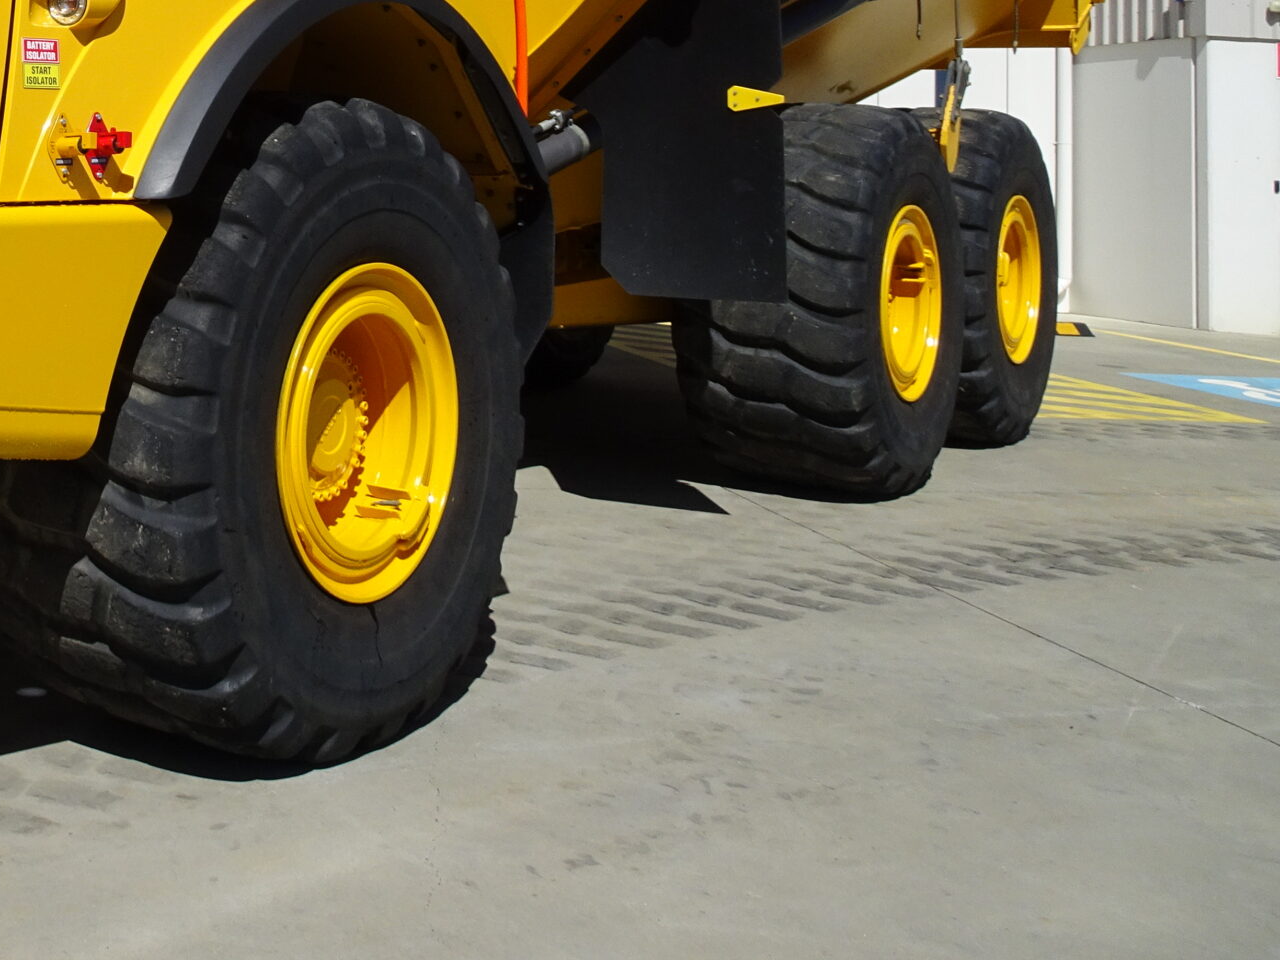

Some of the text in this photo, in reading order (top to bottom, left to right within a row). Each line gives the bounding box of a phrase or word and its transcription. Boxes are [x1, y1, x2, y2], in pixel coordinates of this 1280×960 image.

[26, 41, 55, 50] BATTERY
[26, 51, 56, 60] ISOLATOR
[31, 66, 52, 75] START
[26, 76, 58, 85] ISOLATOR
